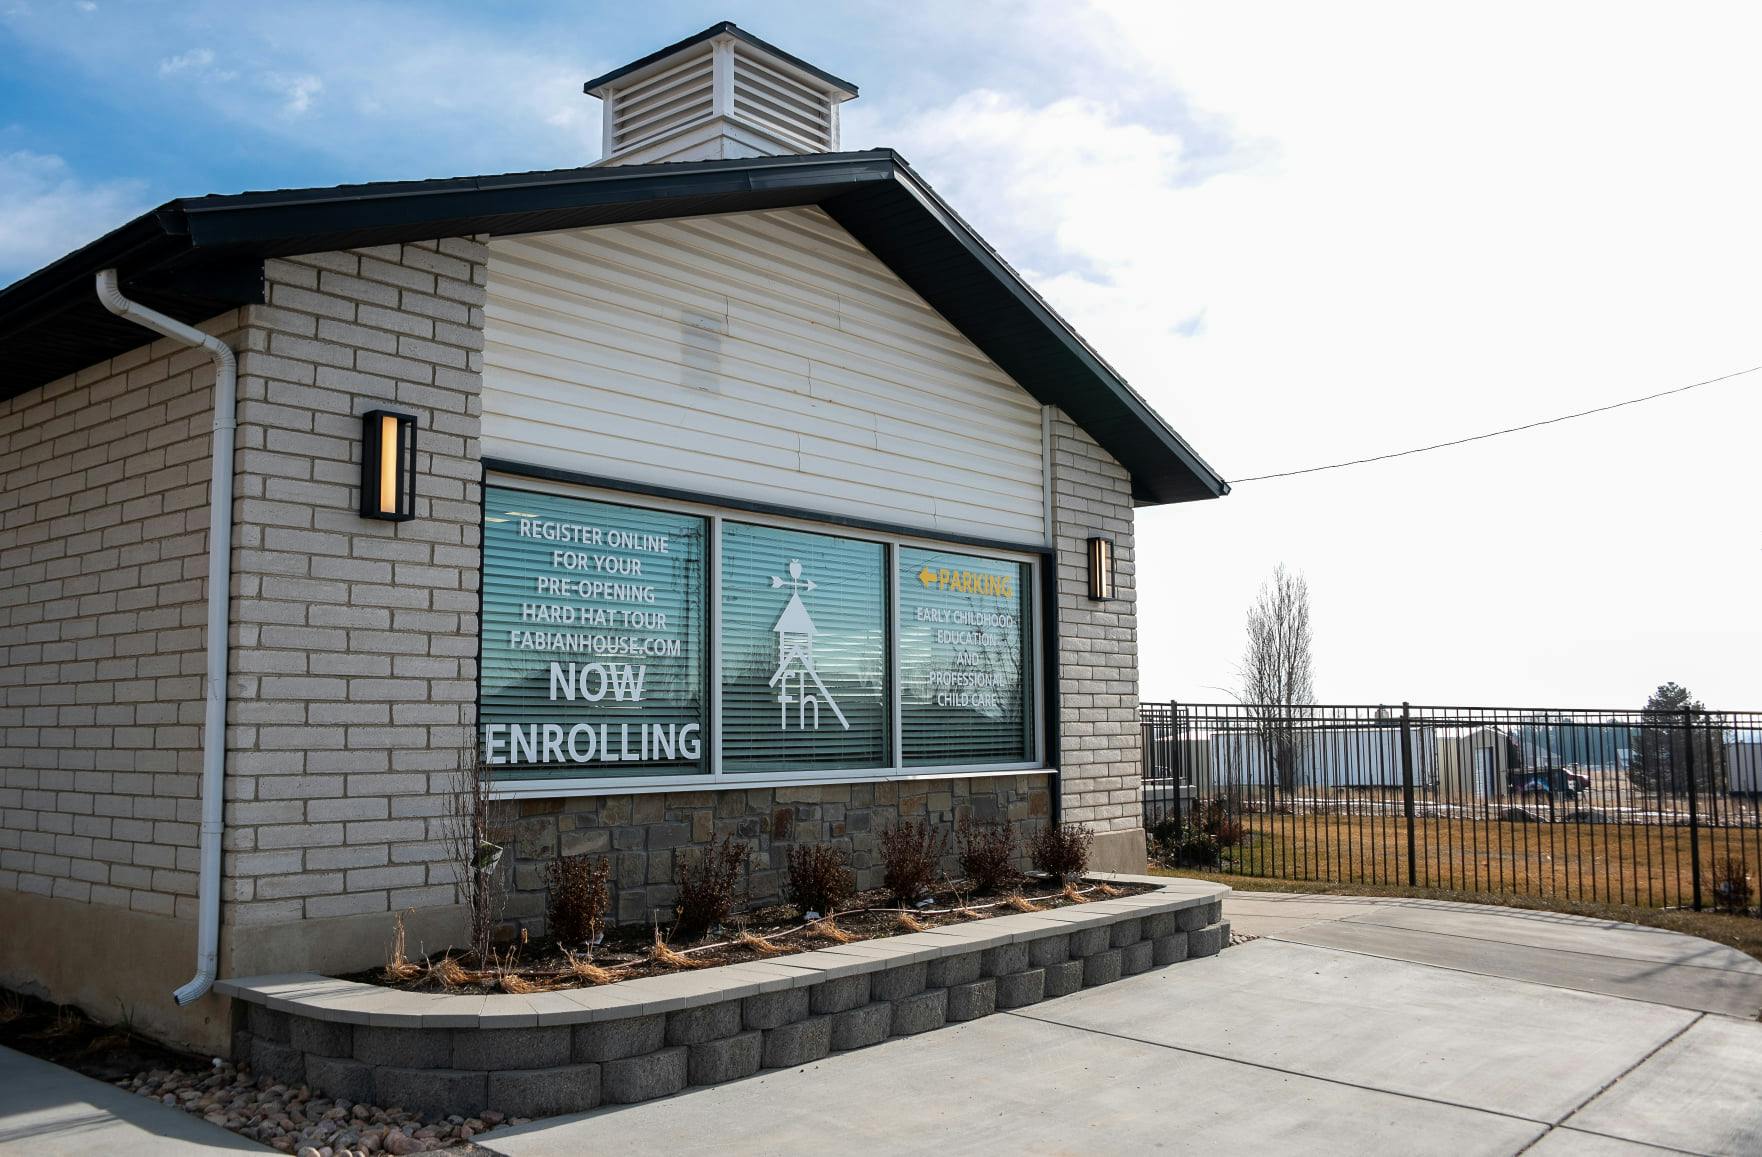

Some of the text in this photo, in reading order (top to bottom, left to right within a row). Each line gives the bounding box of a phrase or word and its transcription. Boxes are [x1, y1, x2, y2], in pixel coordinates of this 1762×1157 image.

[520, 519, 669, 554] REGISTER ONLINE
[553, 551, 641, 576] FOR YOUR
[538, 576, 655, 602] PRE-OPENING
[938, 568, 1014, 599] PARKING
[522, 603, 666, 630] HARD HAT TOUR
[917, 607, 1014, 628] EARLY CHILDHOOD
[510, 631, 681, 657] FABIANHOUSE.COM
[937, 629, 998, 646] EDUCATION
[956, 652, 979, 666] AND
[549, 662, 646, 702] NOW
[929, 671, 1006, 687] PROFESSIONAL
[937, 692, 998, 707] CHILD CARE
[485, 723, 701, 765] ENROLLING
